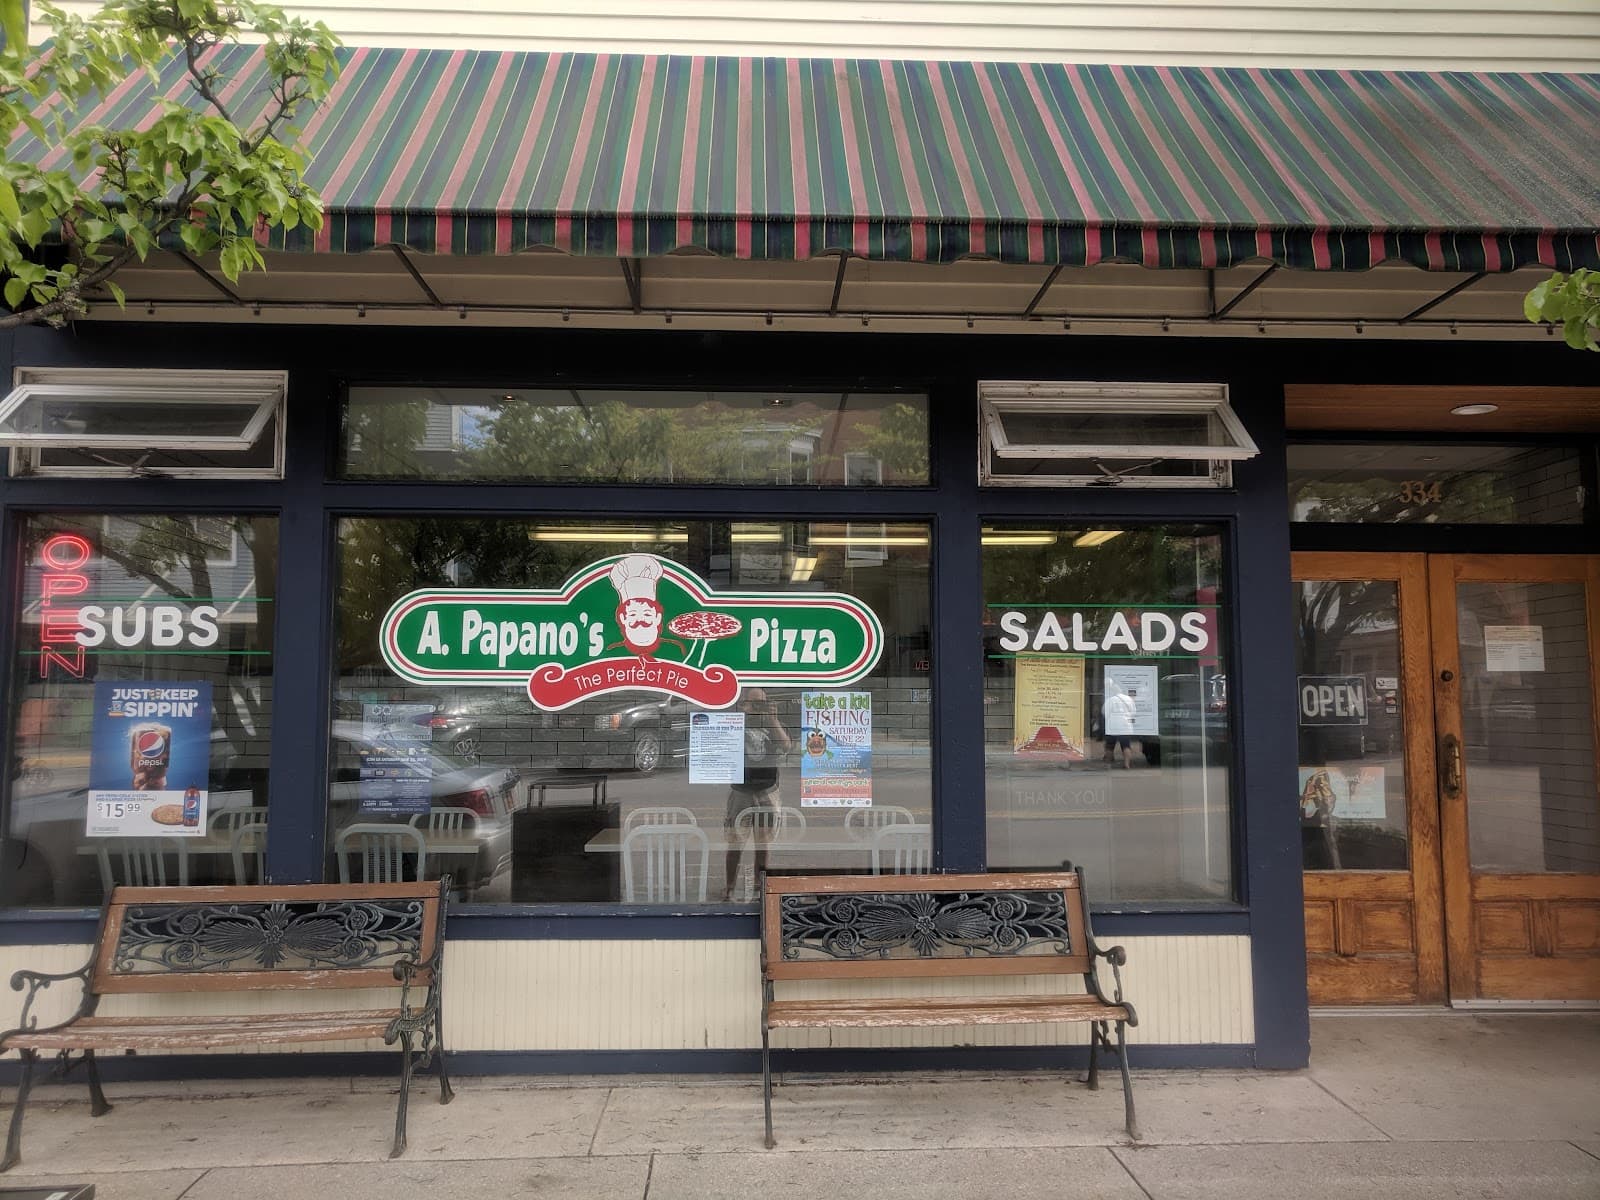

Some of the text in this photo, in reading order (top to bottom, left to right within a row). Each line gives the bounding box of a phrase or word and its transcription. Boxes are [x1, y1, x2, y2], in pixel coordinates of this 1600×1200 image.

[1399, 481, 1441, 503] 334
[41, 535, 90, 678] OPEN
[75, 606, 219, 647] SUBS
[999, 611, 1209, 652] SALADS
[416, 609, 605, 668] A. Papano's
[749, 617, 837, 664] Pizza
[574, 667, 689, 691] The Perfect Pie
[111, 688, 199, 700] JUST KEEP
[803, 692, 836, 710] take
[837, 696, 847, 710] a
[1302, 684, 1366, 717] OPEN
[124, 701, 199, 718] SIPPIN'
[805, 710, 870, 726] FISHING
[829, 727, 868, 735] SATURDAY
[835, 734, 854, 743] JUNE
[138, 759, 165, 768] pepsi
